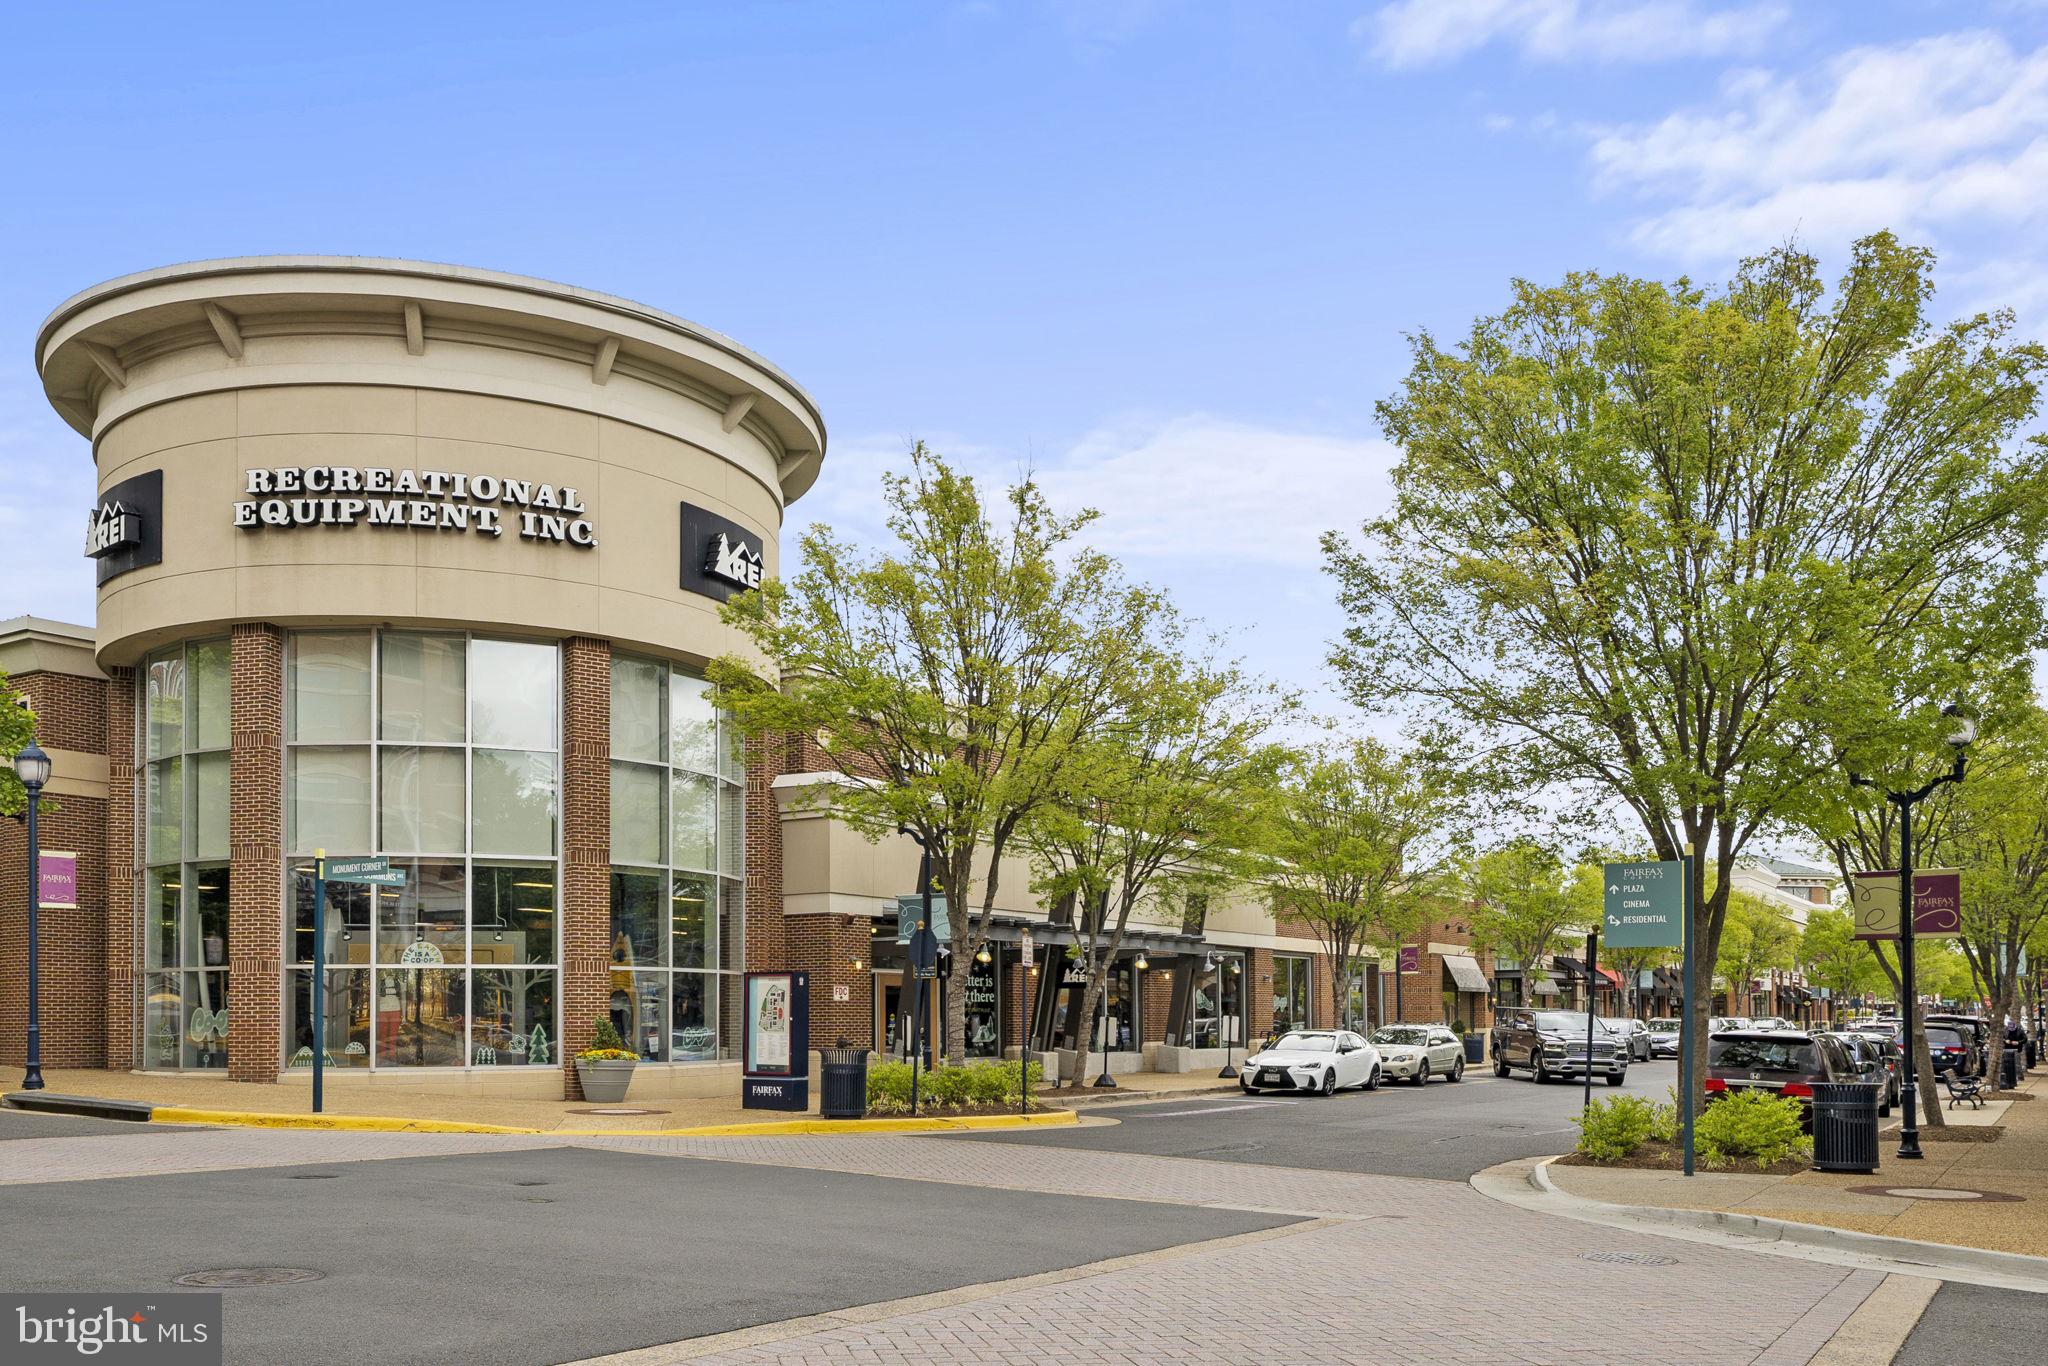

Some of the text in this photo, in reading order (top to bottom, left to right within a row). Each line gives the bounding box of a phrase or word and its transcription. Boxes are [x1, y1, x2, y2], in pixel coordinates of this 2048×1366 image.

[245, 466, 586, 514] RECREATIONAL
[233, 498, 600, 546] EQUIPMENT, INC.
[98, 513, 126, 551] REI
[332, 863, 361, 874] MONUMENT
[361, 861, 382, 872] CORNER
[1623, 867, 1664, 877] FAIRFAX
[43, 874, 72, 882] FAIRFAX
[1623, 884, 1645, 893] PLAZA
[1623, 900, 1650, 909] CINEMA
[1917, 896, 1955, 906] FAIRFAX
[1623, 914, 1667, 924] RESIDENTIAL
[402, 943, 442, 964] THE EARTH
[965, 973, 994, 987] tter is
[835, 987, 848, 996] FDC
[970, 989, 995, 1003] there
[752, 1085, 783, 1095] FAIRFAX
